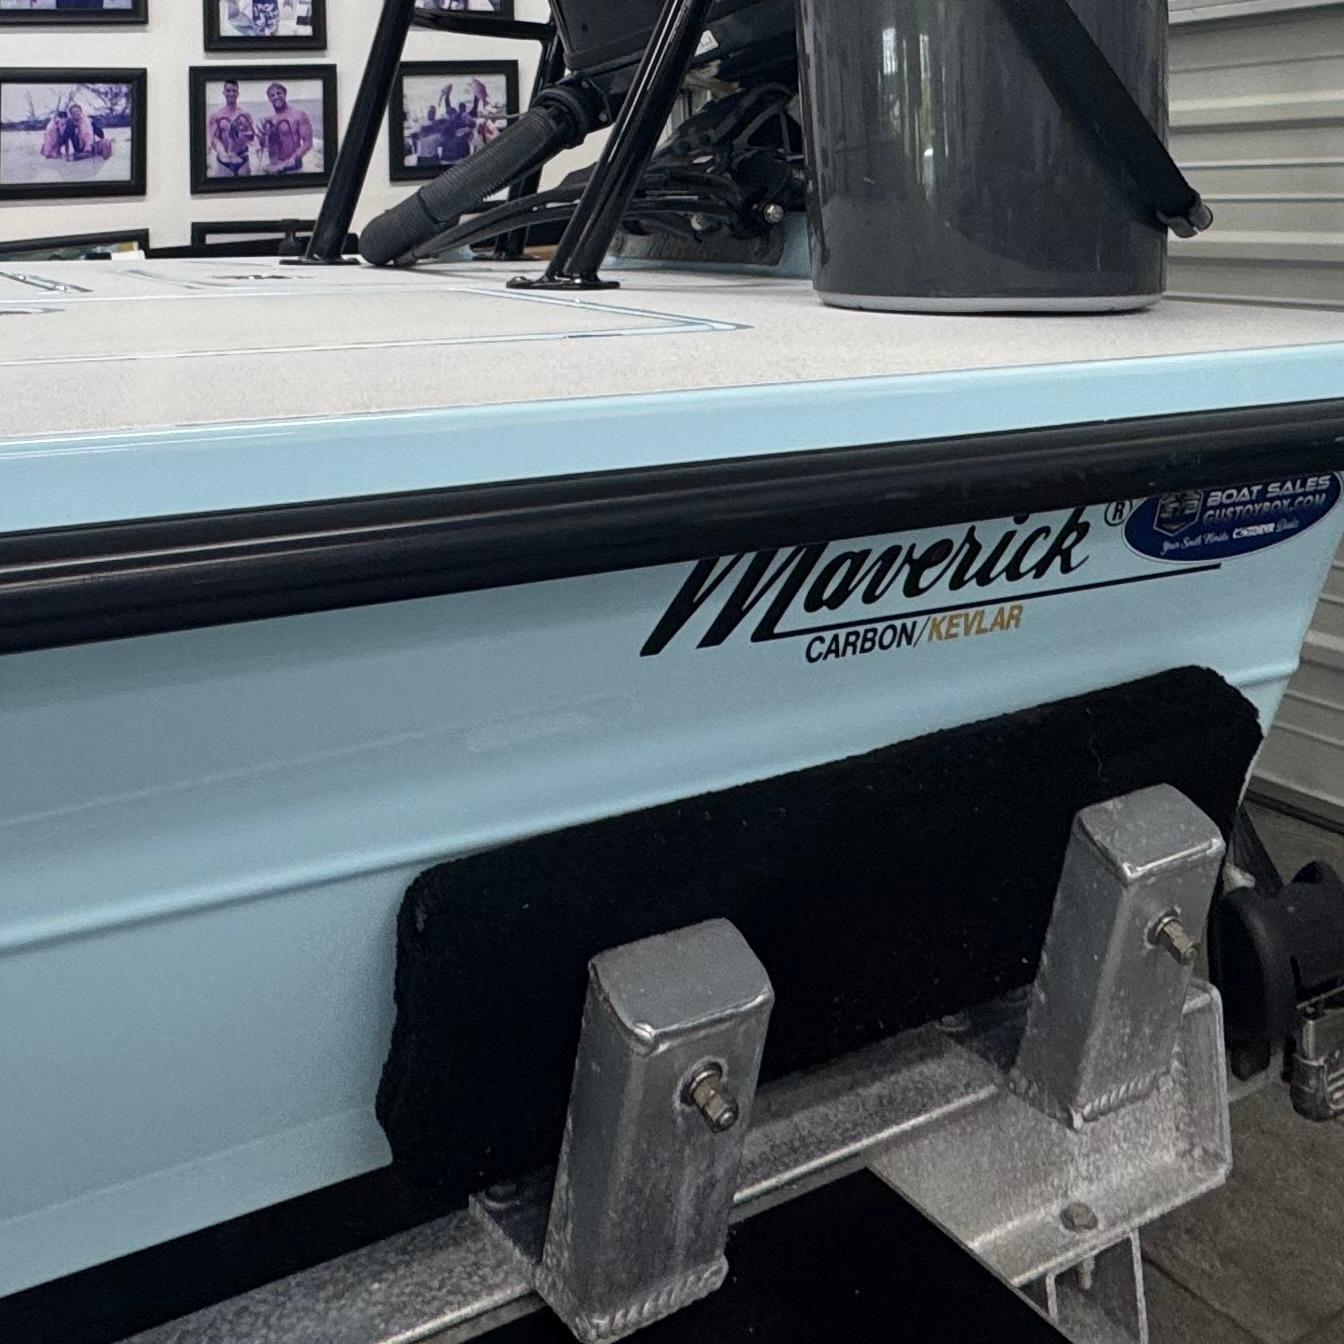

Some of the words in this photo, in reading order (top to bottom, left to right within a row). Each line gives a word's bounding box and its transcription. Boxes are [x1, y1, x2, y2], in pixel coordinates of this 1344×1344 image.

[1206, 484, 1263, 507] BOAT
[1266, 474, 1332, 498] SALES
[640, 508, 1090, 657] Maverick
[805, 605, 1023, 663] CARBON/KEVLAR
